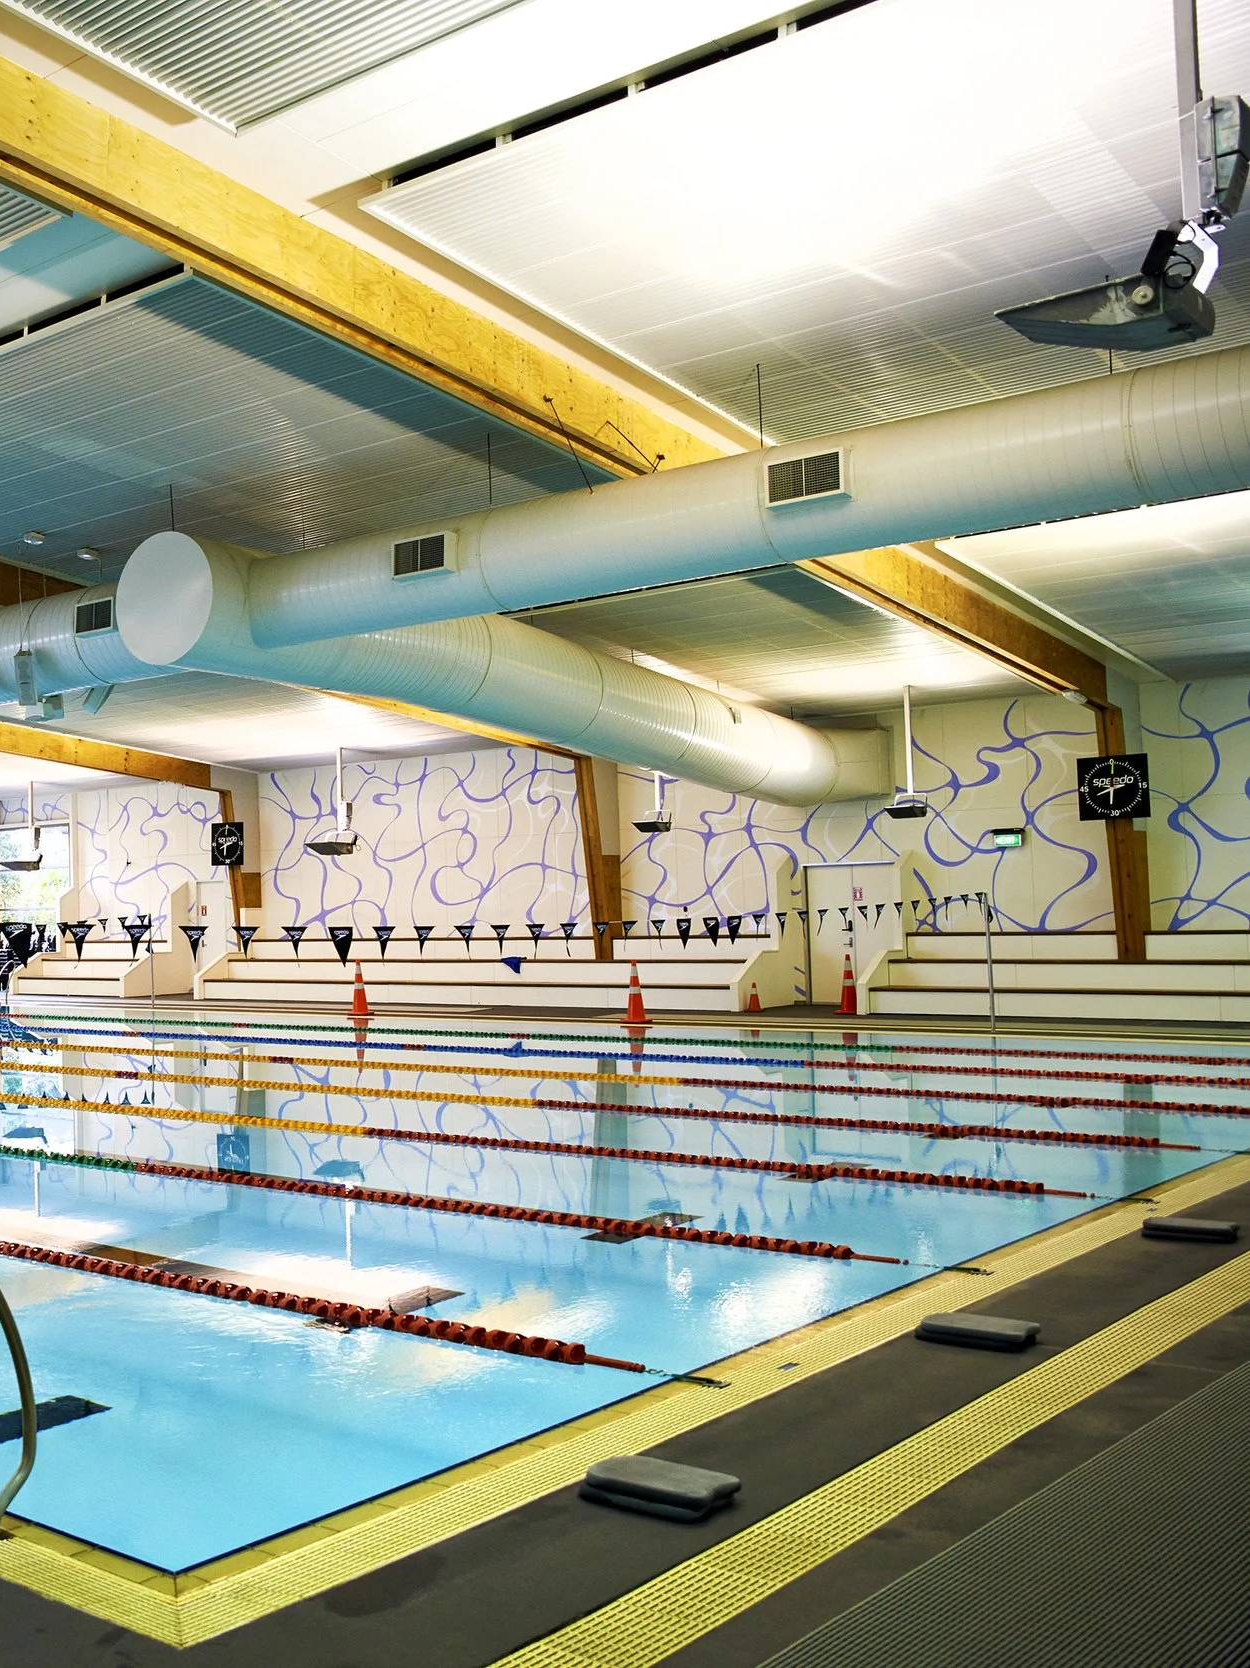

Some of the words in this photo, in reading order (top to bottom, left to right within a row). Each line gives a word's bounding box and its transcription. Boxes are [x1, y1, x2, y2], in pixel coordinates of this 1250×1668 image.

[1093, 775, 1134, 787] speedo
[1138, 781, 1148, 789] 15
[5, 924, 27, 932] speedo
[71, 926, 90, 934] speedo
